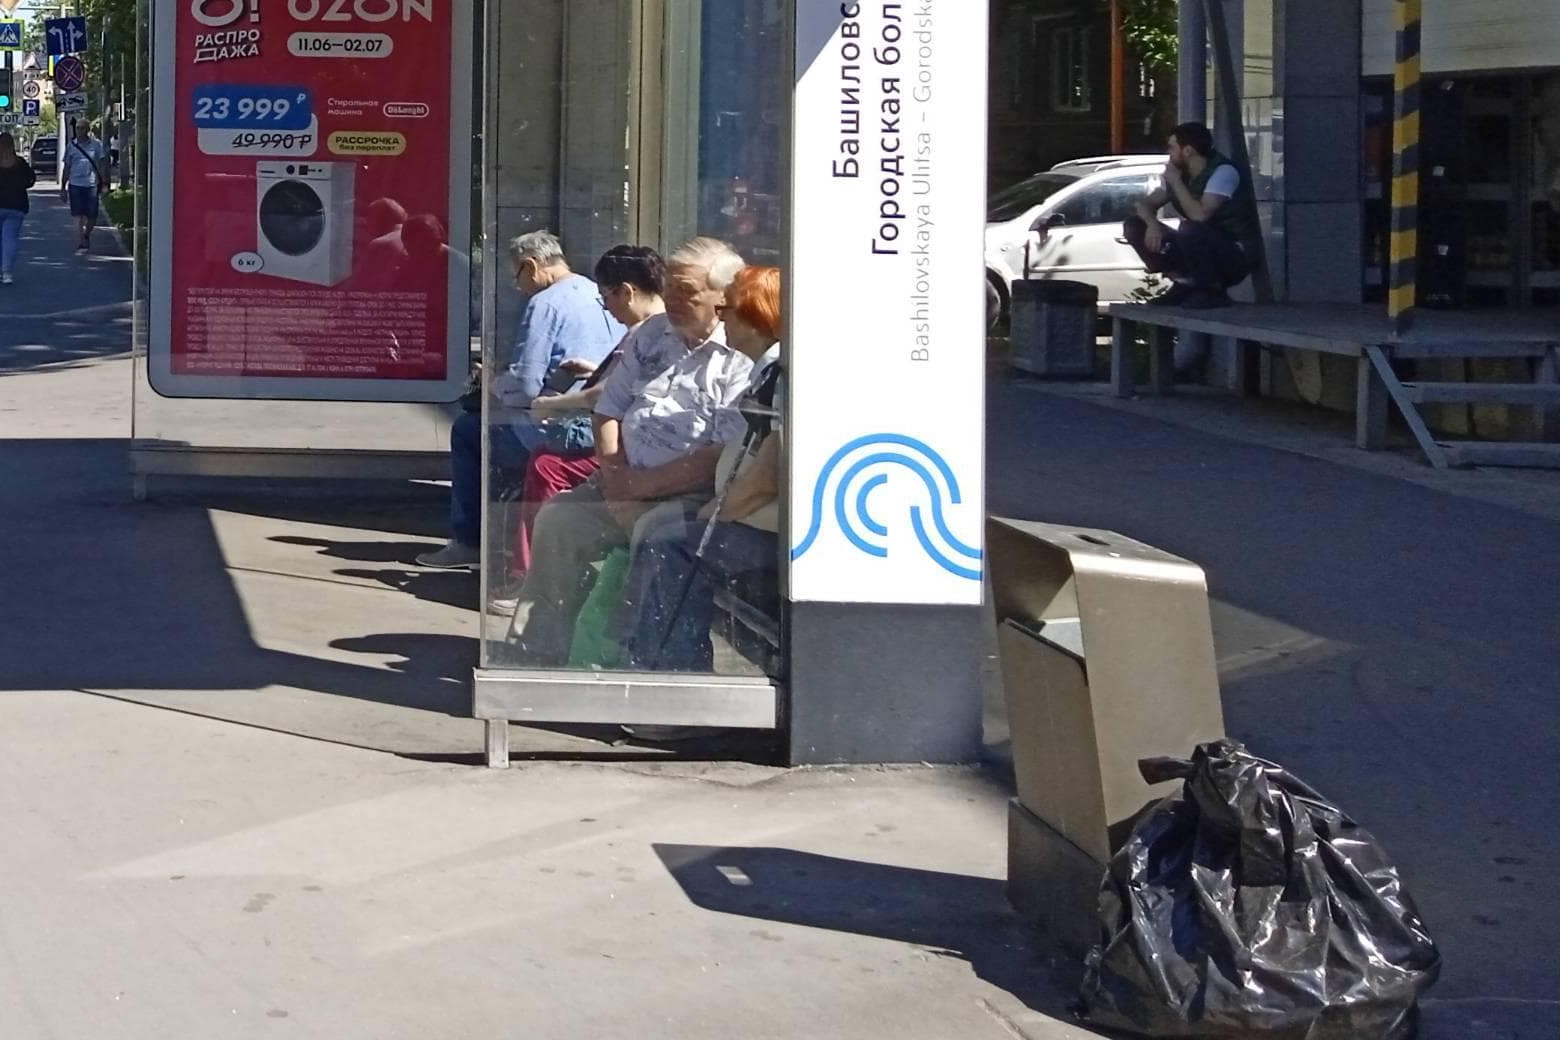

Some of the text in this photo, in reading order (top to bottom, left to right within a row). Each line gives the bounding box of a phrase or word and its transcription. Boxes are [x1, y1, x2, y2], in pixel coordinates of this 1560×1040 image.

[195, 29, 260, 47] РАСПРО
[194, 44, 259, 63] ДАЖА
[27, 86, 37, 94] 40
[327, 97, 379, 107] Стиральная
[335, 136, 400, 145] РАССРОЧКА
[872, 77, 906, 256] Городская
[912, 130, 931, 196] Ulitsa
[910, 205, 933, 363] Bashilovskaya
